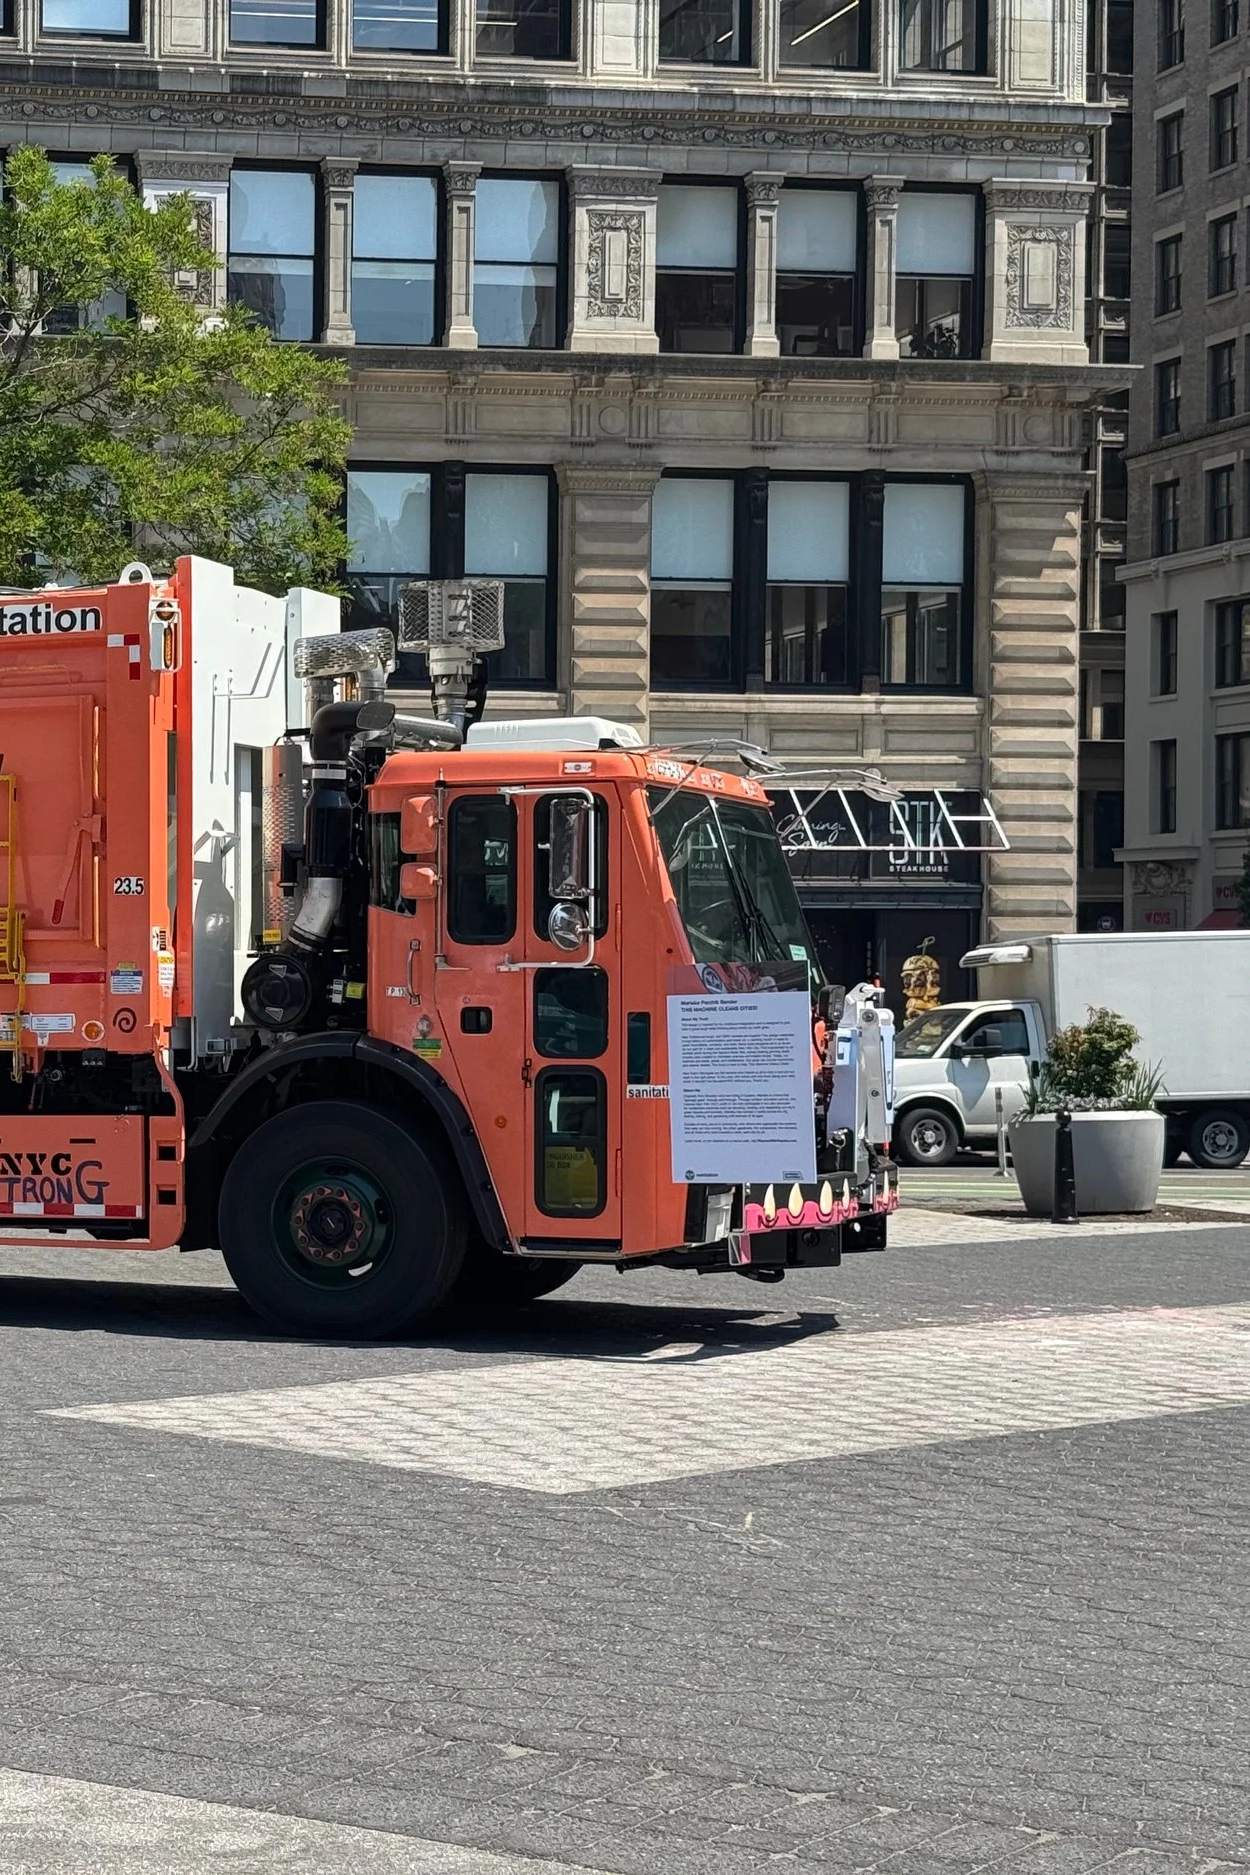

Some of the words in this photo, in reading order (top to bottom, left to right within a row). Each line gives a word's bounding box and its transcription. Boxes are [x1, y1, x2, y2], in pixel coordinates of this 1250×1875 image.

[889, 801, 950, 865] STK
[889, 865, 949, 873] STEAKHOUSE
[114, 877, 144, 895] 23.5
[1153, 911, 1171, 925] CVS
[628, 1086, 670, 1098] sanitati
[0, 1152, 72, 1176] NYC
